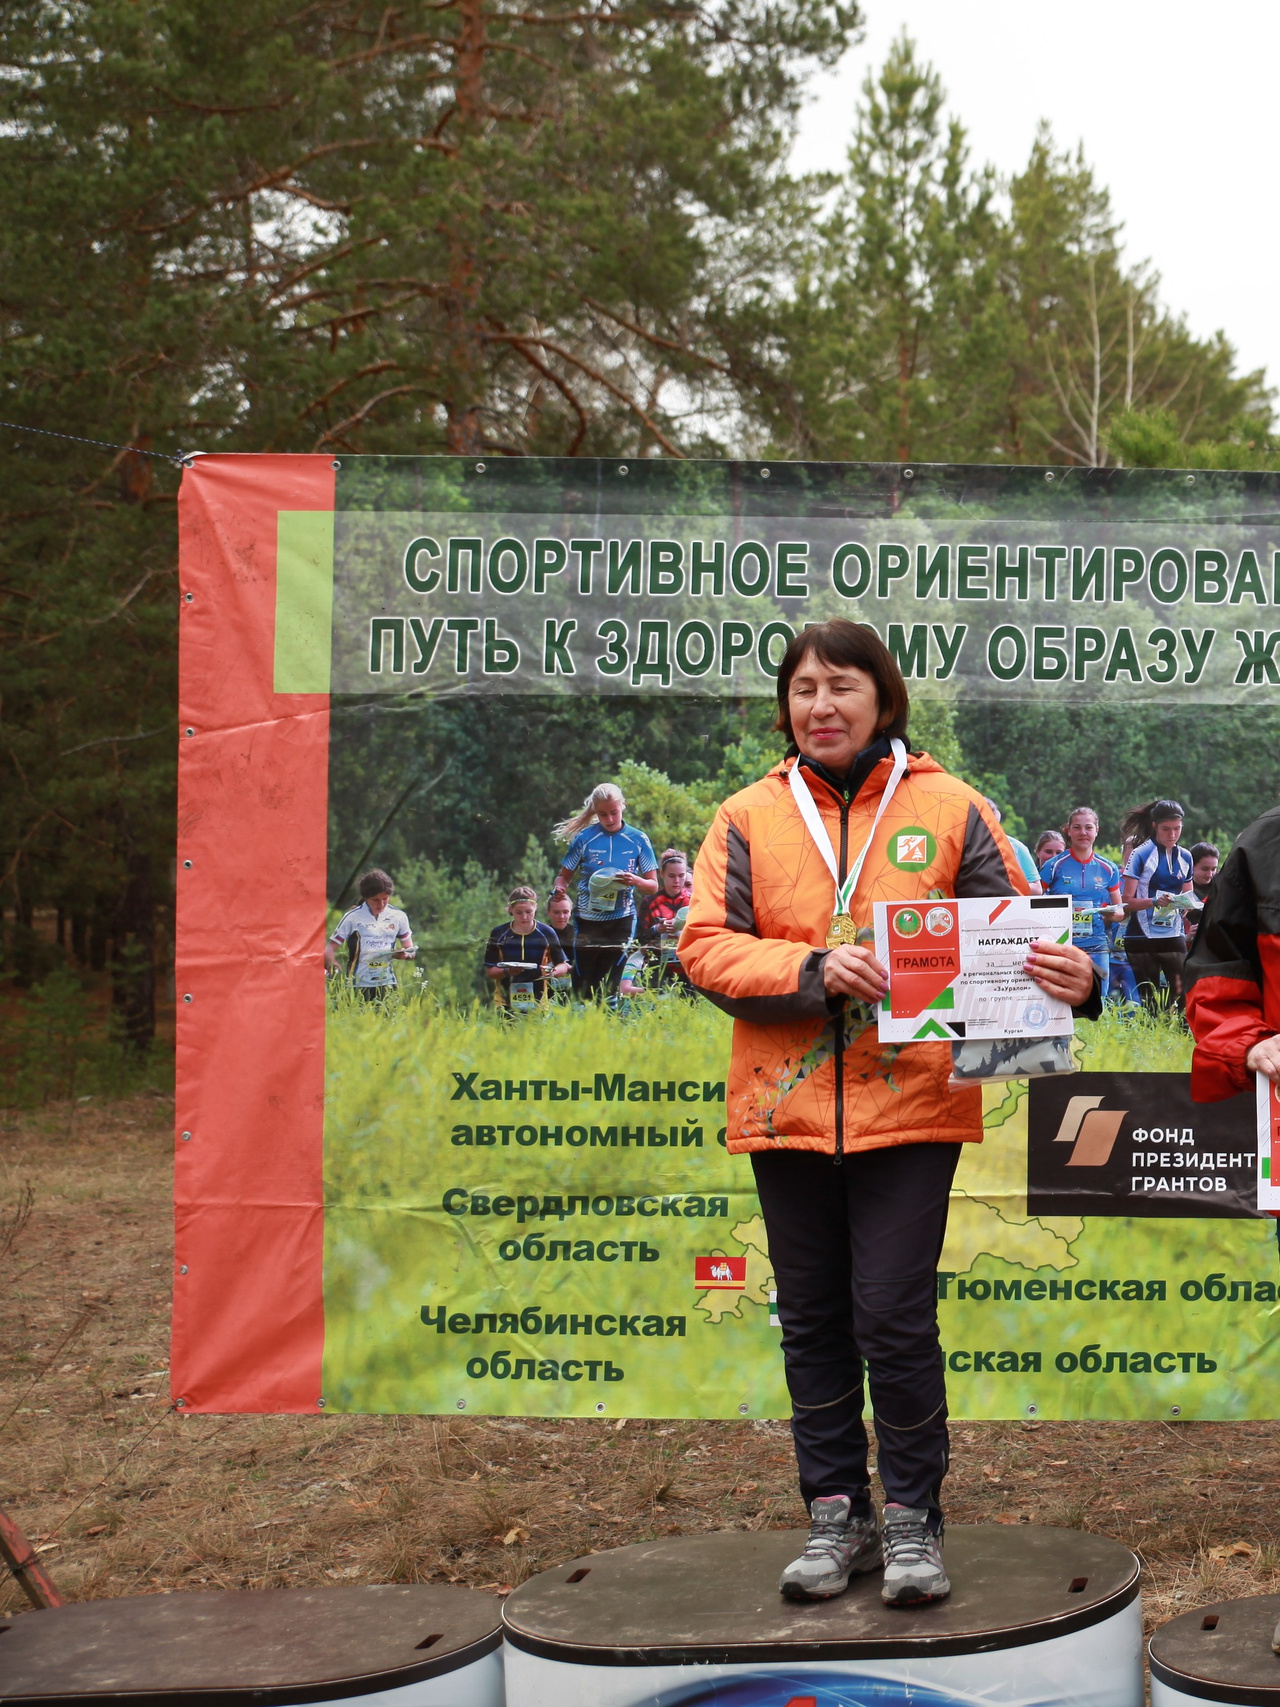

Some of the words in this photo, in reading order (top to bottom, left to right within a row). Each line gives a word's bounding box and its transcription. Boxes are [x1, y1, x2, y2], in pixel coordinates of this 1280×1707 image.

[404, 537, 810, 598] СПОРТИВНОЕ
[369, 617, 520, 675] ПУТЬ
[543, 618, 577, 675] К
[597, 618, 968, 688] ЗДОРОМУ
[987, 623, 1215, 686] ОБРАЗУ
[896, 956, 955, 969] ГРАМОТА
[968, 970, 1012, 978] региональных
[450, 1118, 704, 1148] автономный
[1131, 1126, 1195, 1147] ФОНД
[1131, 1152, 1256, 1171] ПРЕЗИДЕНТ
[1131, 1176, 1228, 1192] ГРАНТОВ
[442, 1187, 729, 1223] Свердловская
[499, 1232, 660, 1262] область
[936, 1271, 1167, 1302] Тюменская
[420, 1305, 687, 1337] Челябинская
[466, 1350, 625, 1381] область
[1054, 1344, 1218, 1374] область
